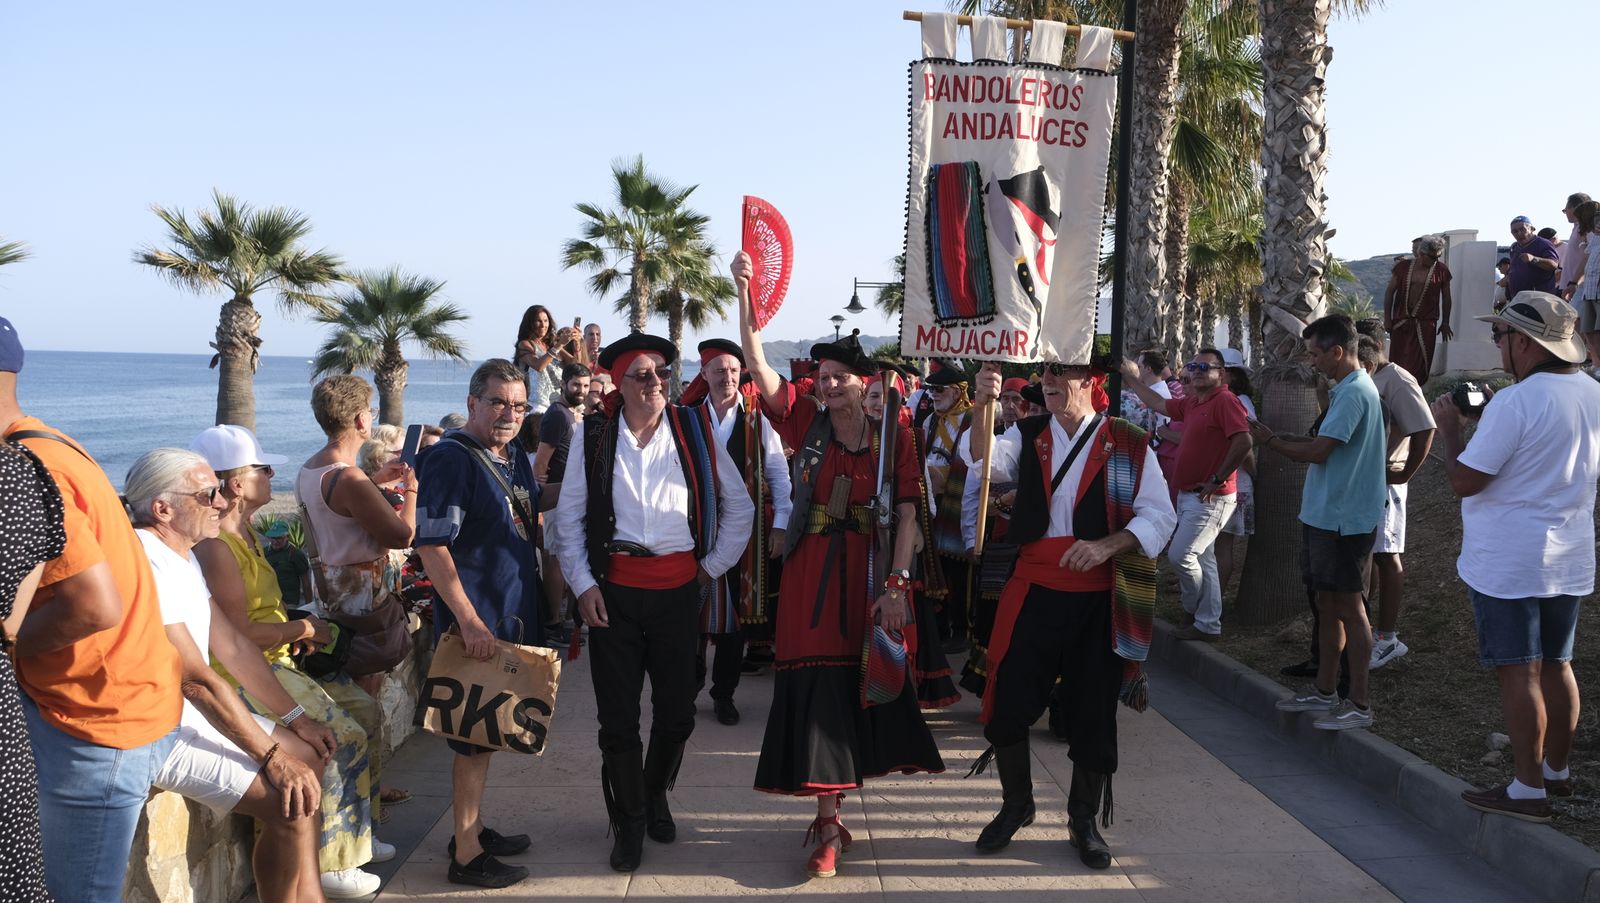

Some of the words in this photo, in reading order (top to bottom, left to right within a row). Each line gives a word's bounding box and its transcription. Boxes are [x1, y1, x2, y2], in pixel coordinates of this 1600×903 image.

[924, 73, 1084, 112] BANDOLEROS
[943, 112, 1089, 148] ANDALUCES
[916, 325, 1029, 357] MOJACAR
[412, 677, 552, 754] RKS
